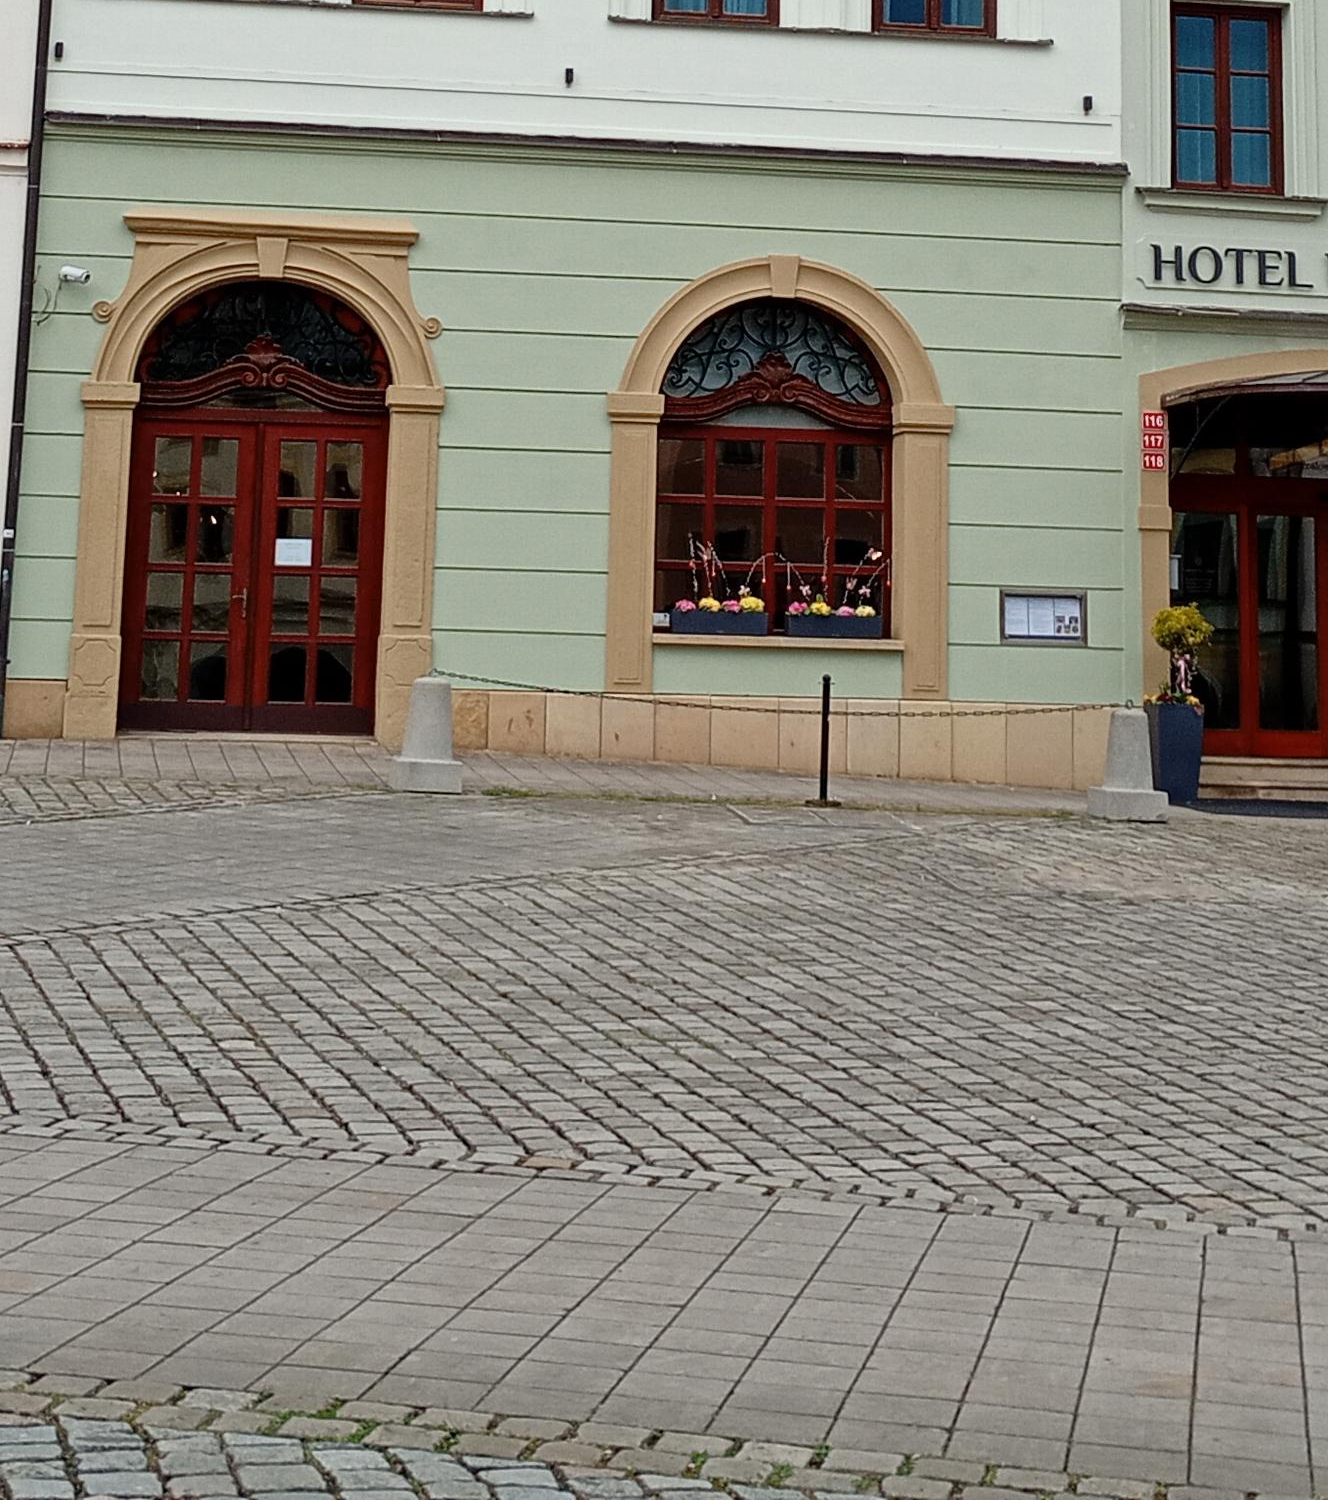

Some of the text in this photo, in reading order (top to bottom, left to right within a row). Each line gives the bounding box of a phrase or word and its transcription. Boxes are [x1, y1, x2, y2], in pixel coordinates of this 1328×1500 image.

[1150, 243, 1314, 289] HOTEL
[1144, 414, 1164, 428] 116
[1143, 434, 1163, 448] 117
[1144, 455, 1164, 468] 118
